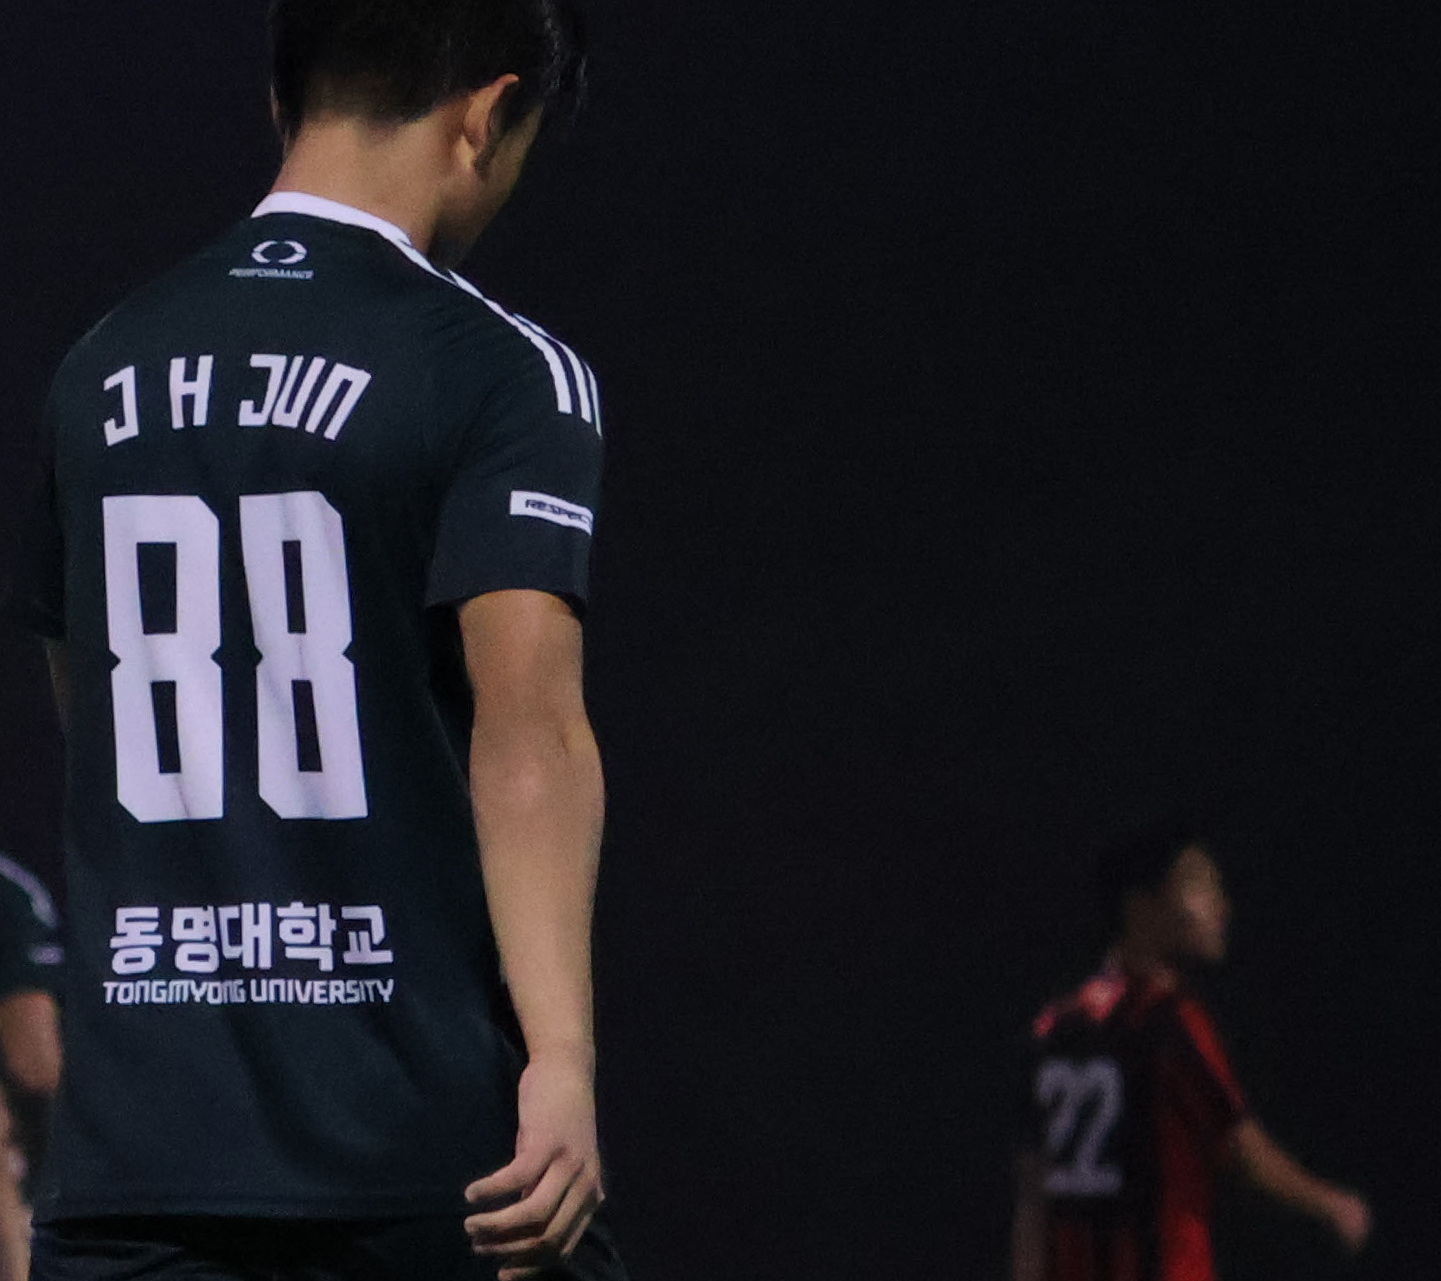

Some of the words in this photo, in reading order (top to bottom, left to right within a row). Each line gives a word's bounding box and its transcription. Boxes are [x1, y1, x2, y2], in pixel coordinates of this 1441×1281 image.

[103, 365, 140, 447] J
[168, 353, 214, 430] H
[237, 353, 372, 441] JUN
[102, 490, 370, 824] 88
[109, 901, 394, 975] 동명대학교
[102, 978, 248, 1006] TONGMYONG
[249, 978, 395, 1006] UNIVERSITY
[1034, 1055, 1126, 1197] 22
